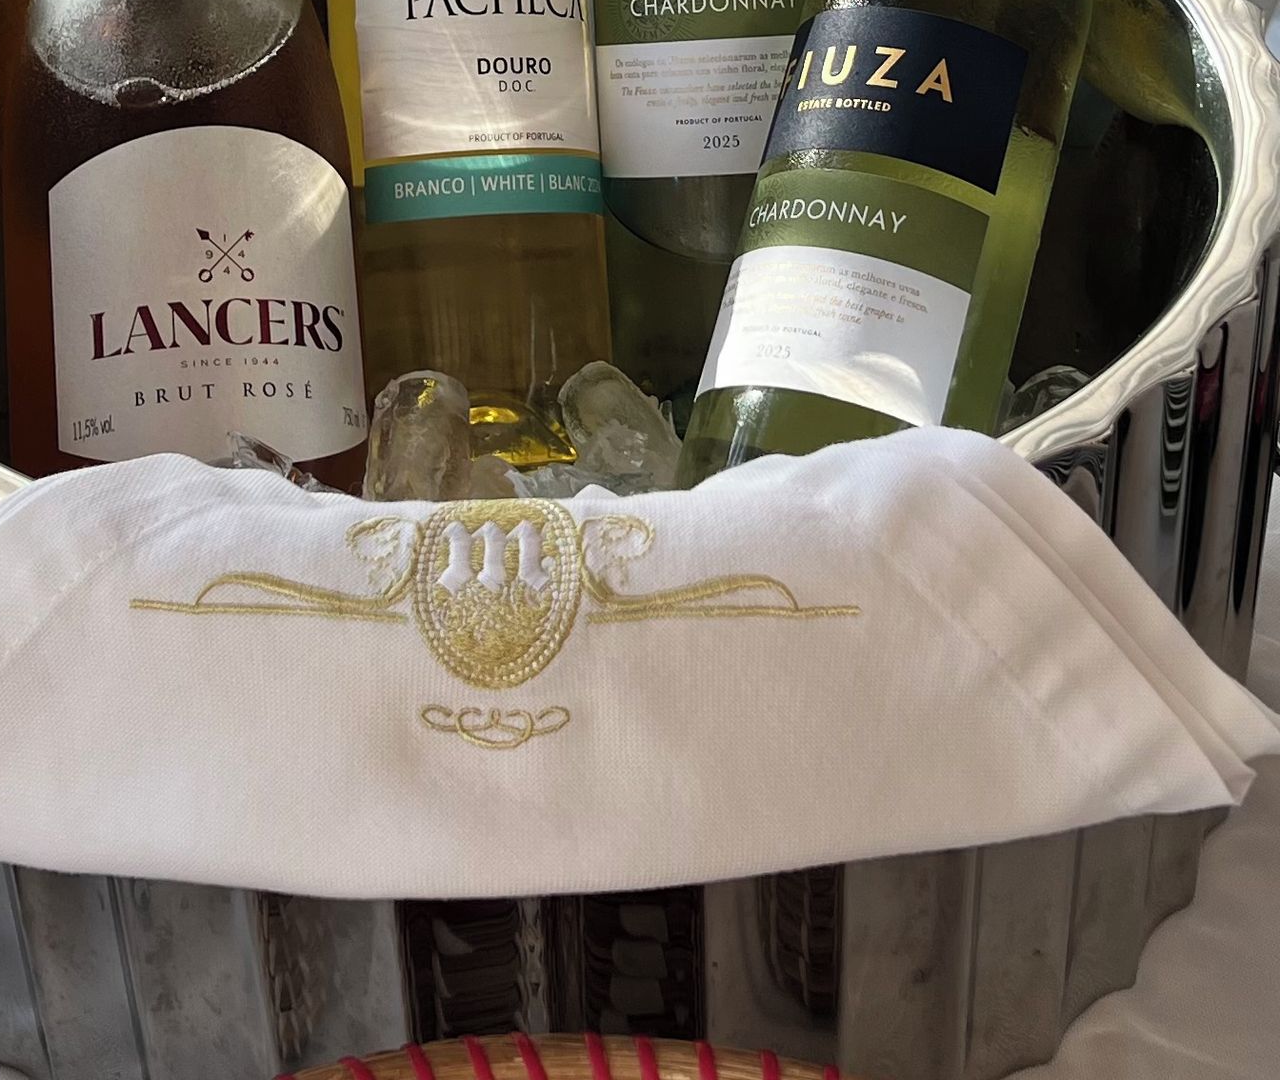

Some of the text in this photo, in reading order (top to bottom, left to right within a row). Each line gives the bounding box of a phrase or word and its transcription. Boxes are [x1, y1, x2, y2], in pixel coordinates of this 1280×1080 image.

[477, 57, 552, 75] DOURO
[780, 45, 953, 104] FIUZA
[797, 97, 892, 112] ESTATE BOTTLED
[675, 114, 763, 126] PRODUCT OF PORTUGAL
[468, 131, 565, 143] PRODUCT OF PORTUGAL
[703, 134, 740, 150] 2025
[394, 177, 466, 200] BRANCO
[480, 173, 536, 192] WHITE
[548, 173, 586, 192] BLANC
[748, 198, 907, 235] CHARDONNAY
[89, 297, 345, 361] LANCERS
[755, 344, 792, 360] 2025
[180, 357, 280, 369] SINCE 1944
[133, 380, 314, 408] BRUT ROSÉ
